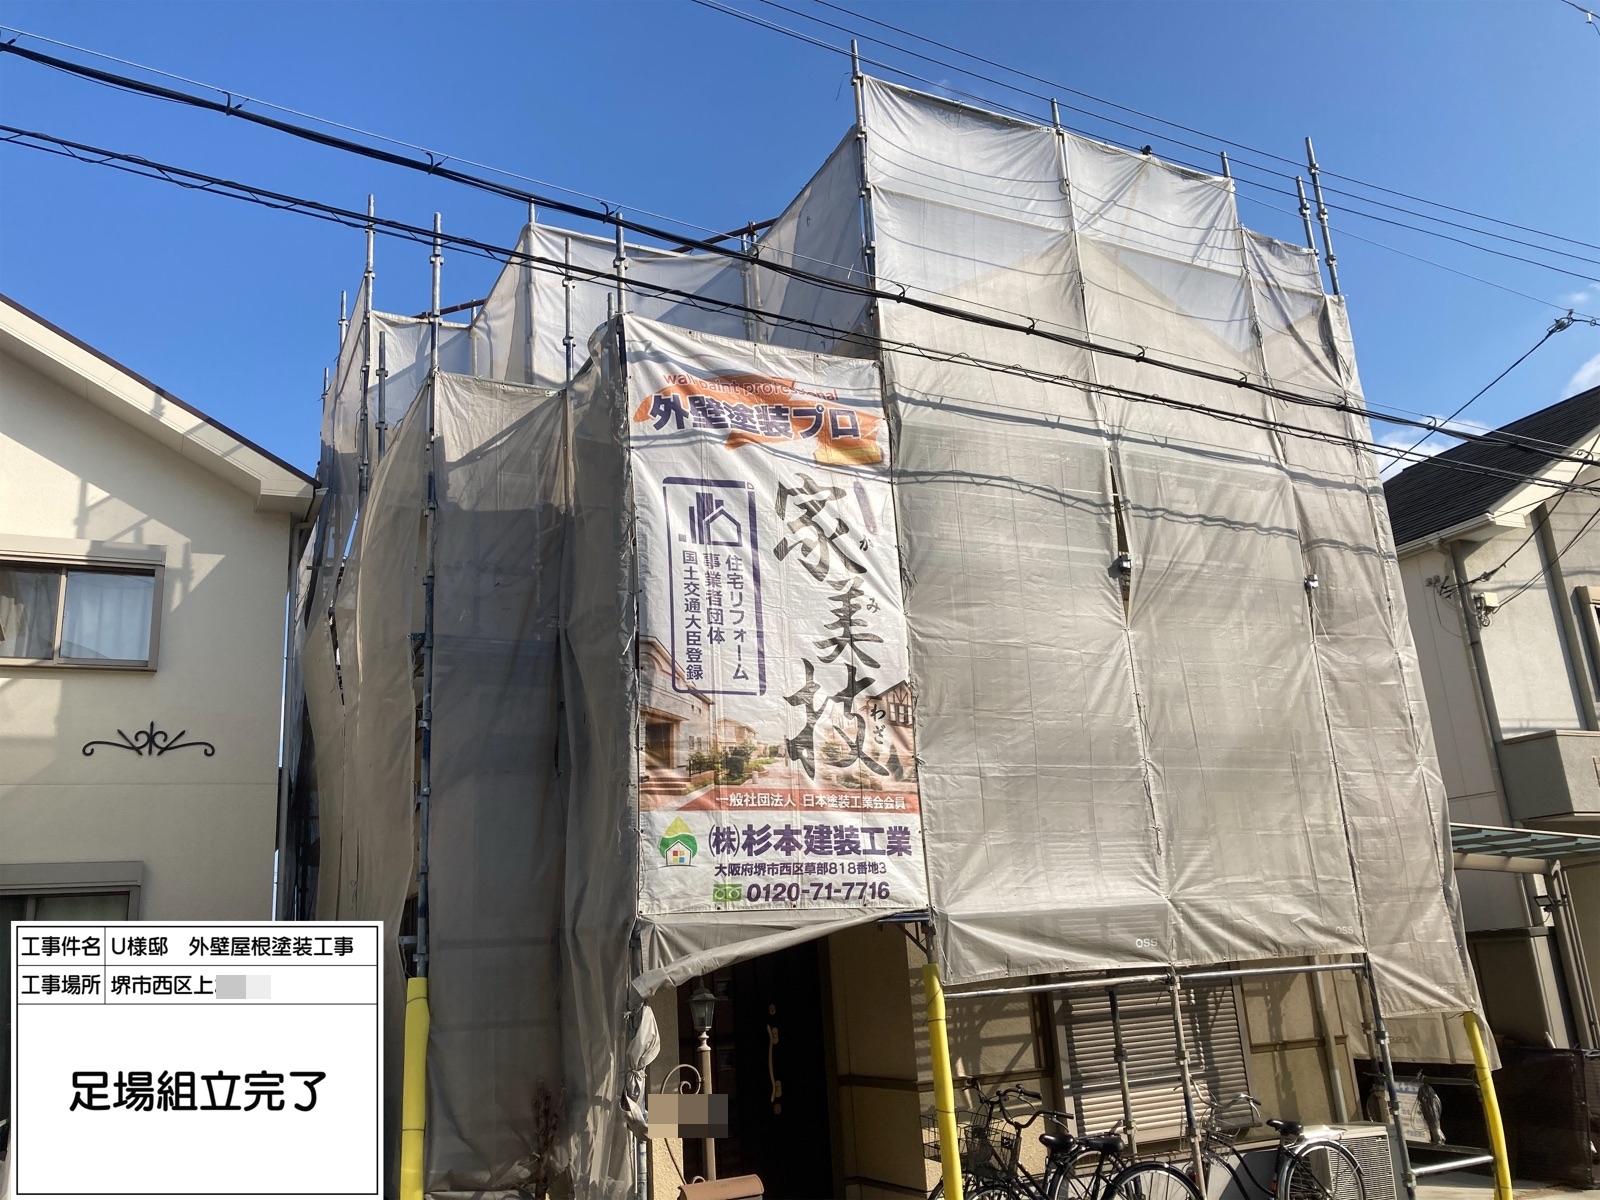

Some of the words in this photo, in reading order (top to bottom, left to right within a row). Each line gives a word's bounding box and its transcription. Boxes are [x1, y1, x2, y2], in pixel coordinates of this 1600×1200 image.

[663, 374, 696, 386] wall
[700, 380, 740, 394] paint
[744, 382, 839, 401] professional
[649, 393, 861, 440] 外壁塗装プロ
[703, 553, 725, 645] 事業者団体
[682, 550, 703, 680] 国土交通大臣登録
[725, 554, 749, 681] 住宅リフォーム
[870, 704, 886, 745] わざ
[716, 792, 796, 808] 一般社団法人
[803, 793, 906, 810] 日本塗装工業会会員
[714, 861, 887, 877] 大阪府堺市西区草部818番地3
[747, 881, 890, 902] 0120-71-7716
[1135, 938, 1158, 949] OSS
[1335, 925, 1354, 935] OSS
